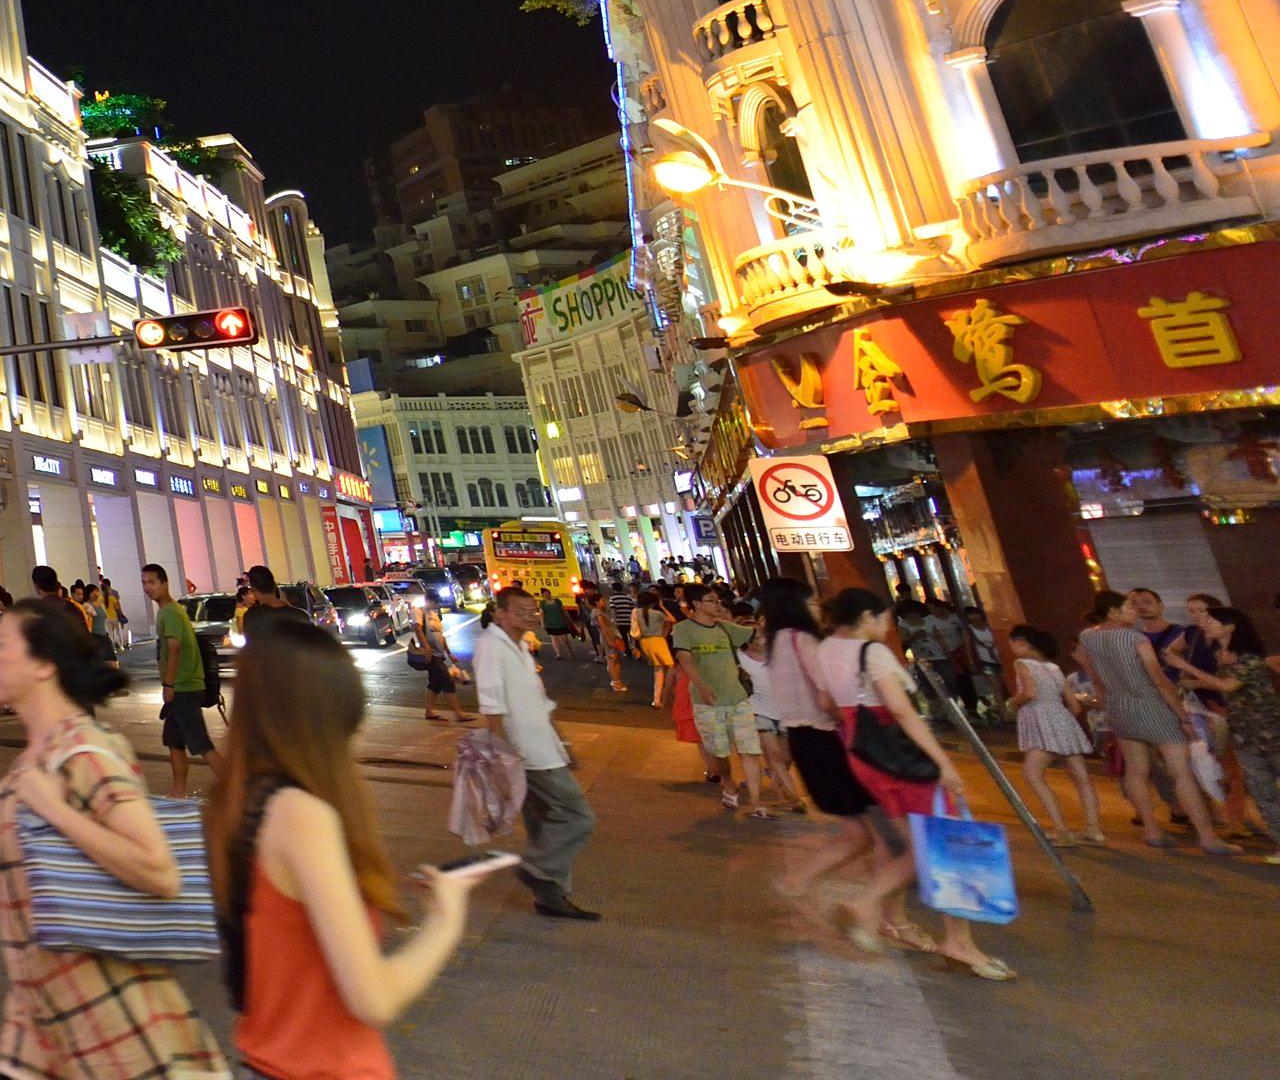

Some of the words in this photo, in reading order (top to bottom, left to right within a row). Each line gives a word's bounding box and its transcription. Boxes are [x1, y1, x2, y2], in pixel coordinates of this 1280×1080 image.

[853, 291, 1243, 418] 金鹭首
[775, 533, 847, 547] 电动自行车
